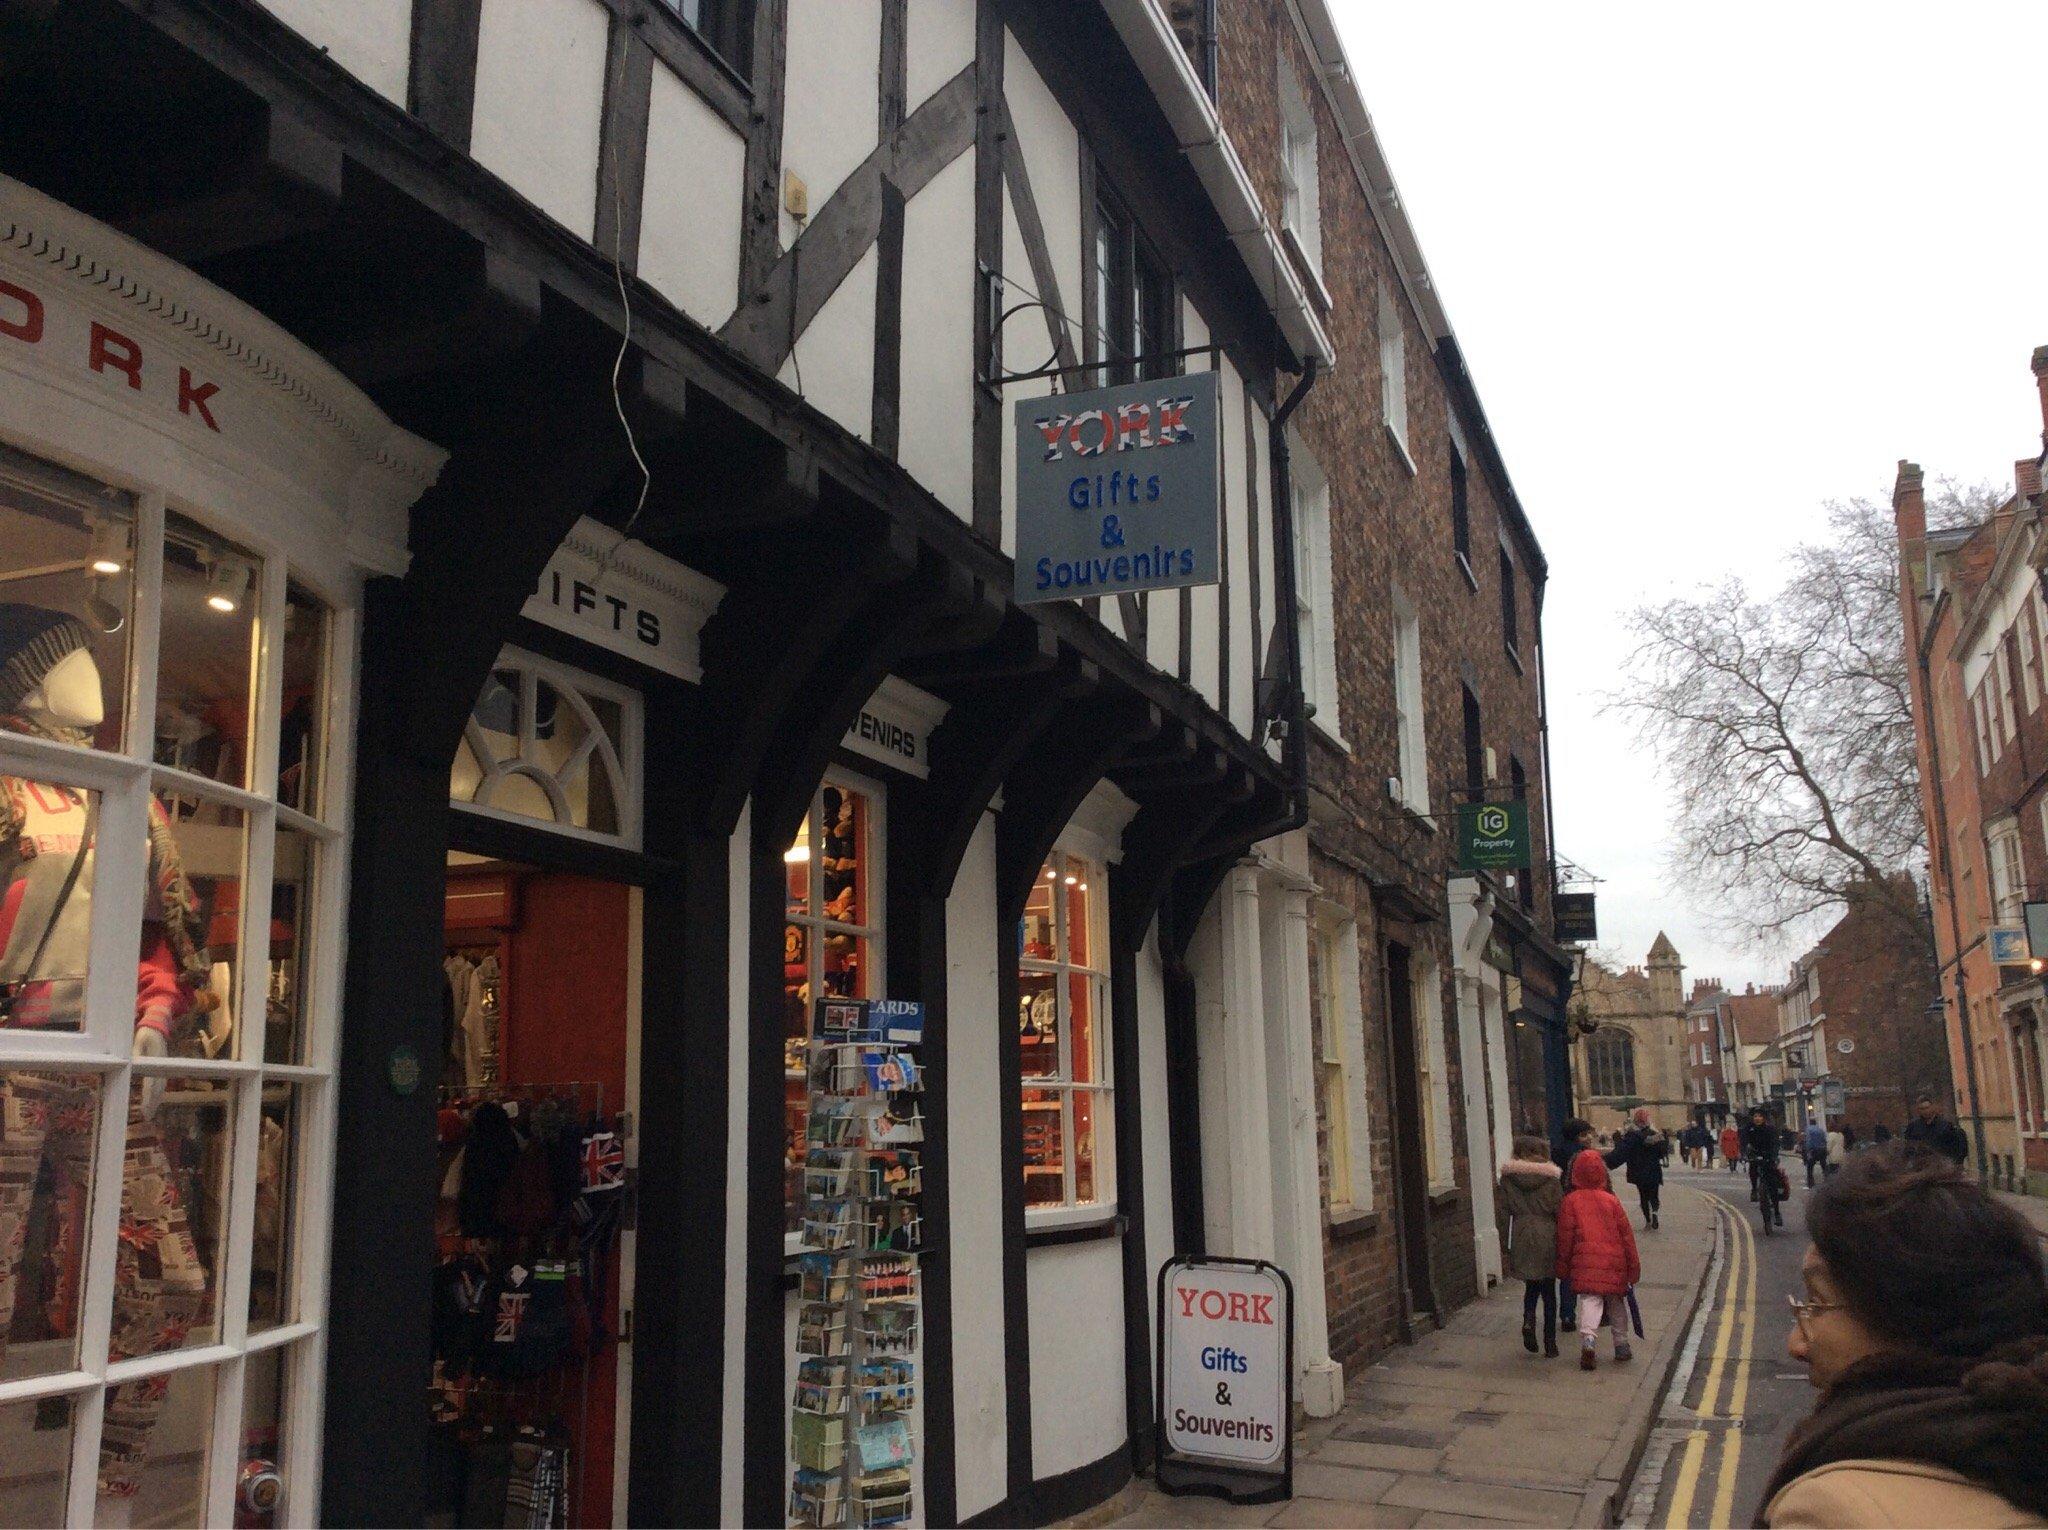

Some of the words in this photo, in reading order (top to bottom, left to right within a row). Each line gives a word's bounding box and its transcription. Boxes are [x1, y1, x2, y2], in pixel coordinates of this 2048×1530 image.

[0, 279, 221, 434] ORK
[1034, 396, 1196, 462] YORK
[1068, 470, 1162, 511] Gifts
[1101, 514, 1125, 548] &
[1036, 545, 1197, 591] Souvenirs
[552, 570, 661, 646] IFTS
[1484, 814, 1503, 829] IG
[1473, 837, 1516, 849] Property
[1177, 1287, 1274, 1325] YORK
[1201, 1346, 1248, 1374] Gifts
[1215, 1381, 1232, 1407] &
[1174, 1408, 1274, 1443] Souvenirs
